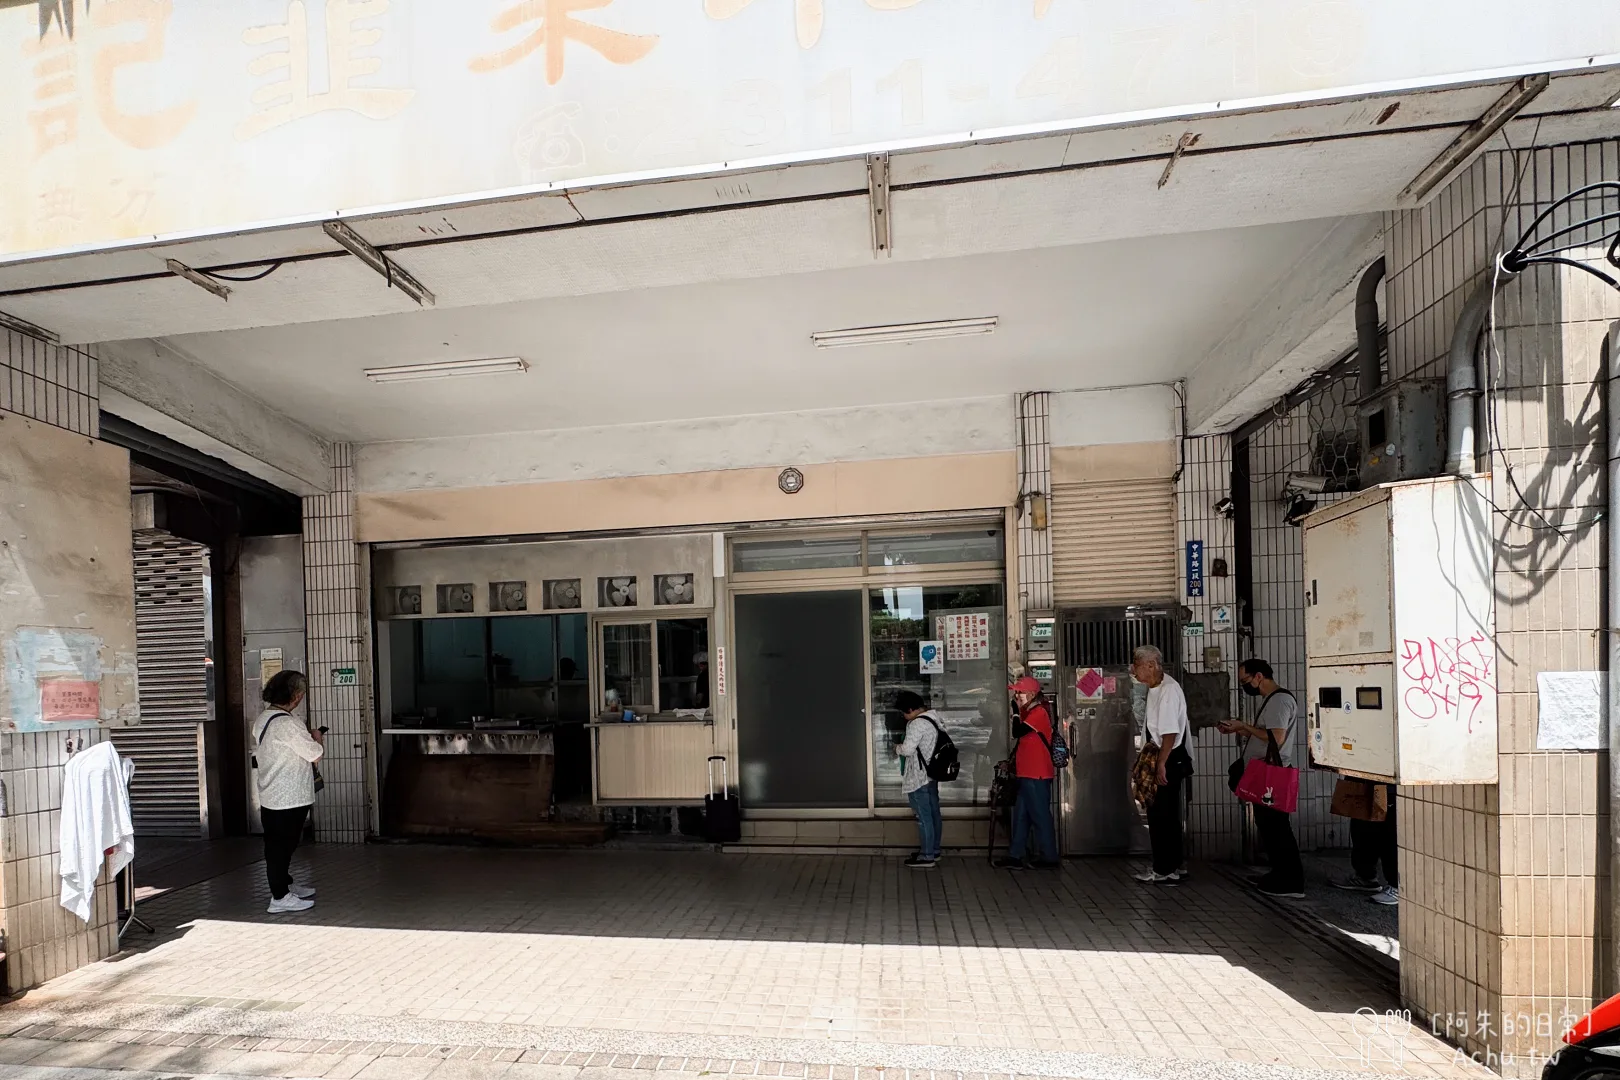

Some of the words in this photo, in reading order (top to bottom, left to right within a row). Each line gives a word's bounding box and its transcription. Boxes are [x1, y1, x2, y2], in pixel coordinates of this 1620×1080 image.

[1189, 543, 1202, 596] 中華路一段200號
